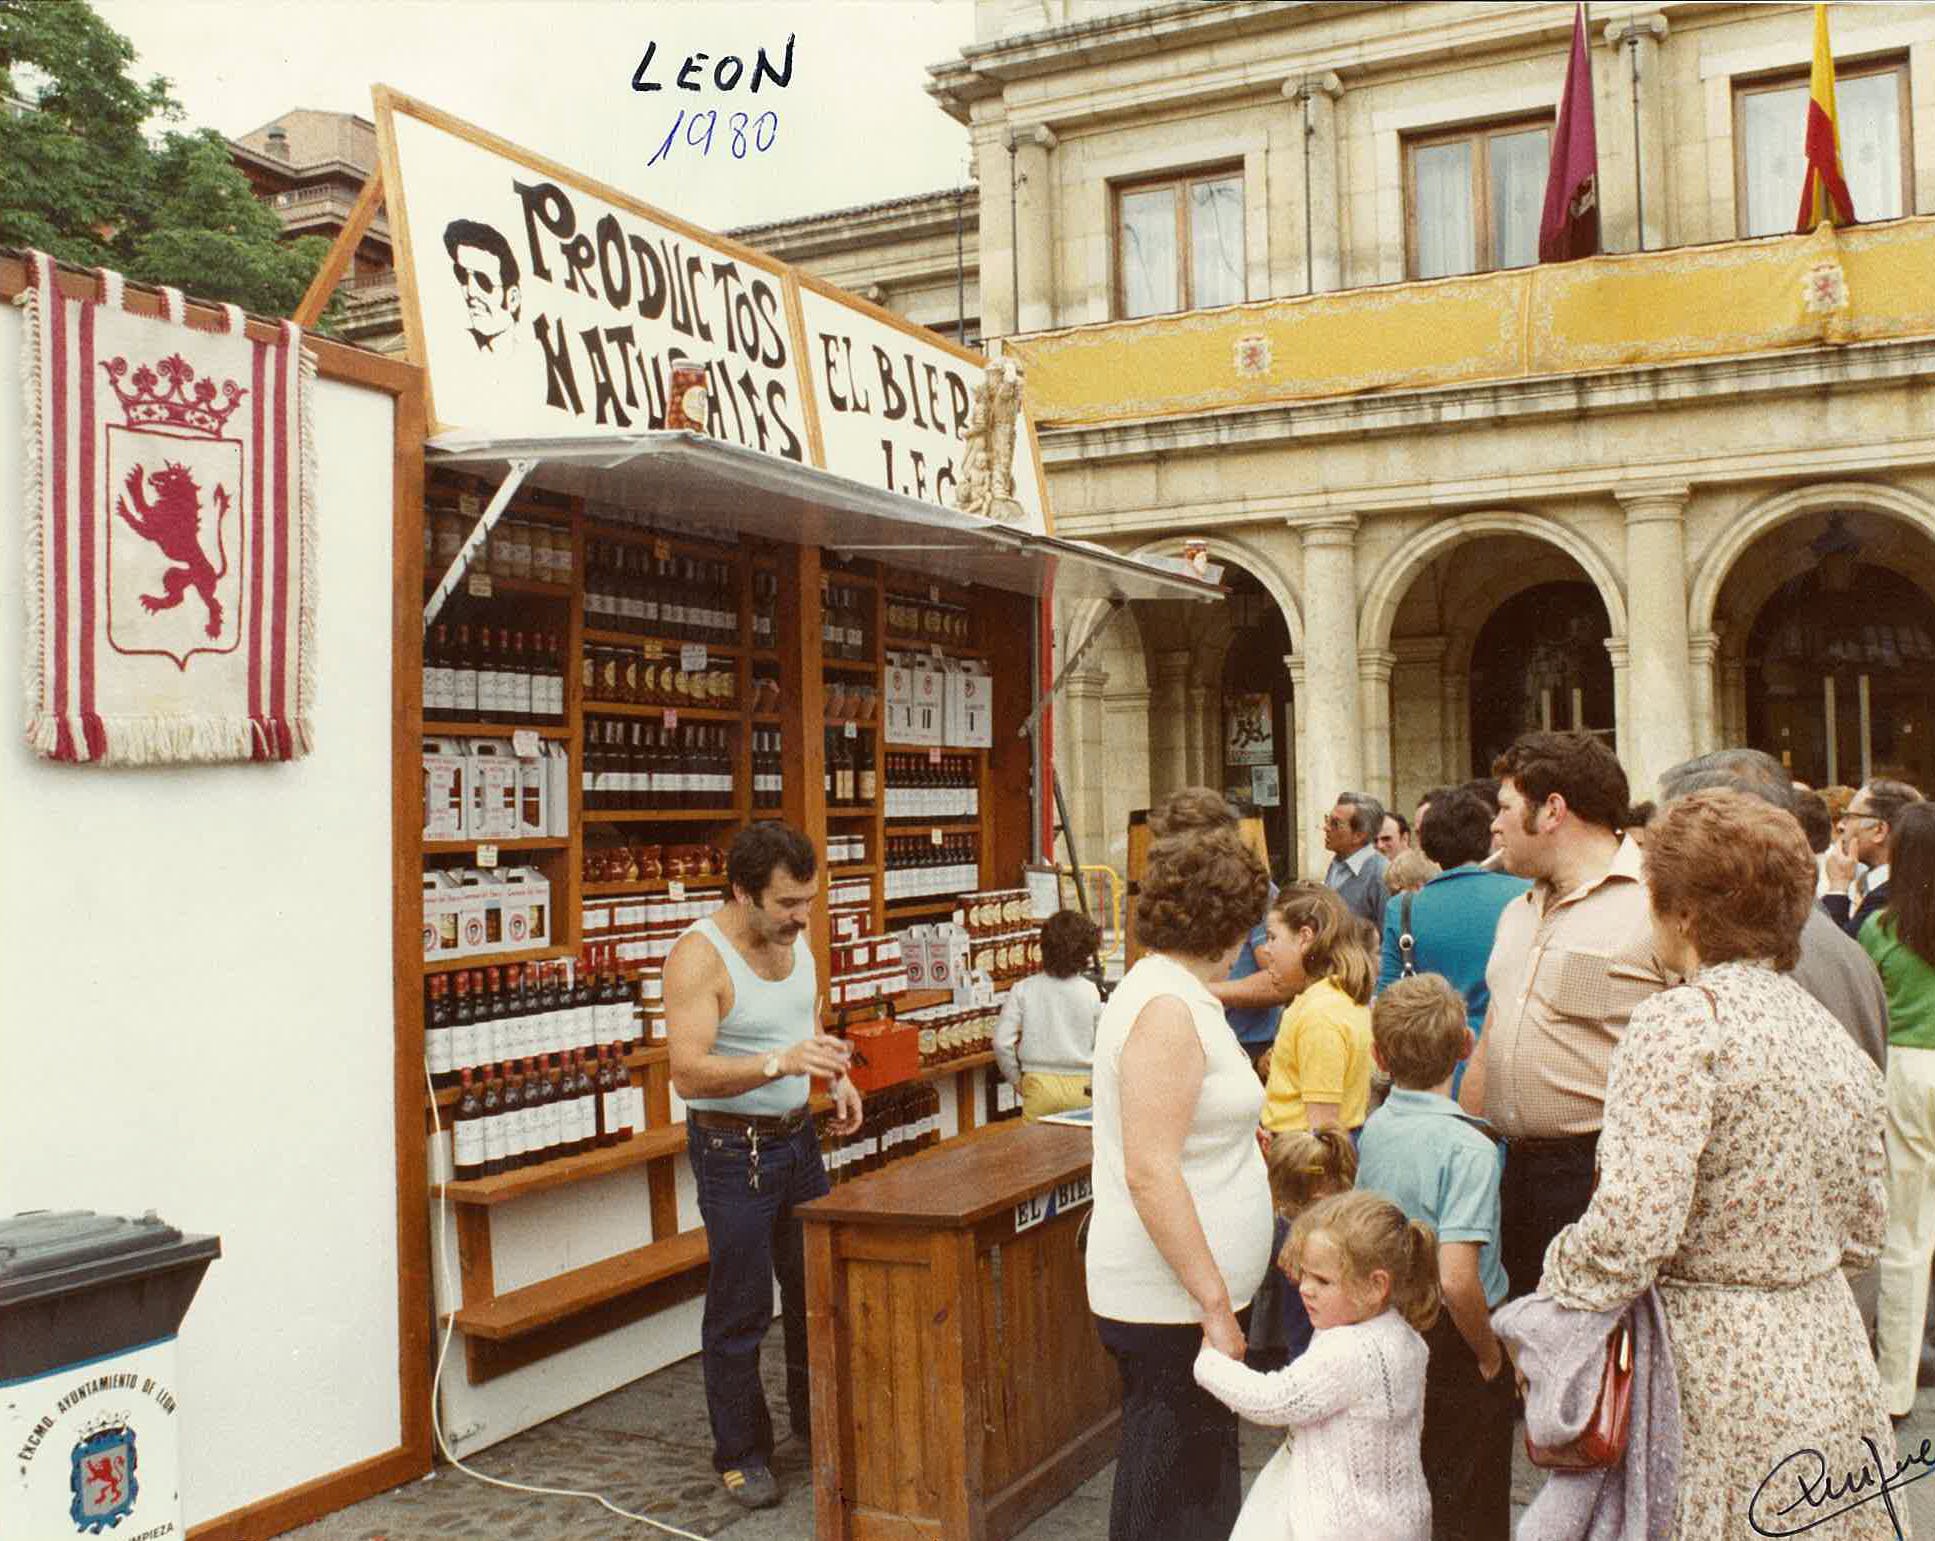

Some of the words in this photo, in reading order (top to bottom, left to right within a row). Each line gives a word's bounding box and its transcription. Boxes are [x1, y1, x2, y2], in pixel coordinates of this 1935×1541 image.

[512, 179, 787, 369] PRODUCTOS
[532, 312, 802, 463] NATUALES
[818, 332, 871, 414] EL
[872, 344, 971, 441] BIER
[1018, 1200, 1041, 1226] EL
[1059, 1178, 1092, 1208] BIE
[58, 1374, 138, 1414] AYUNTAMIENTO
[142, 1378, 156, 1395] DE
[128, 1521, 175, 1541] MPIEZA
